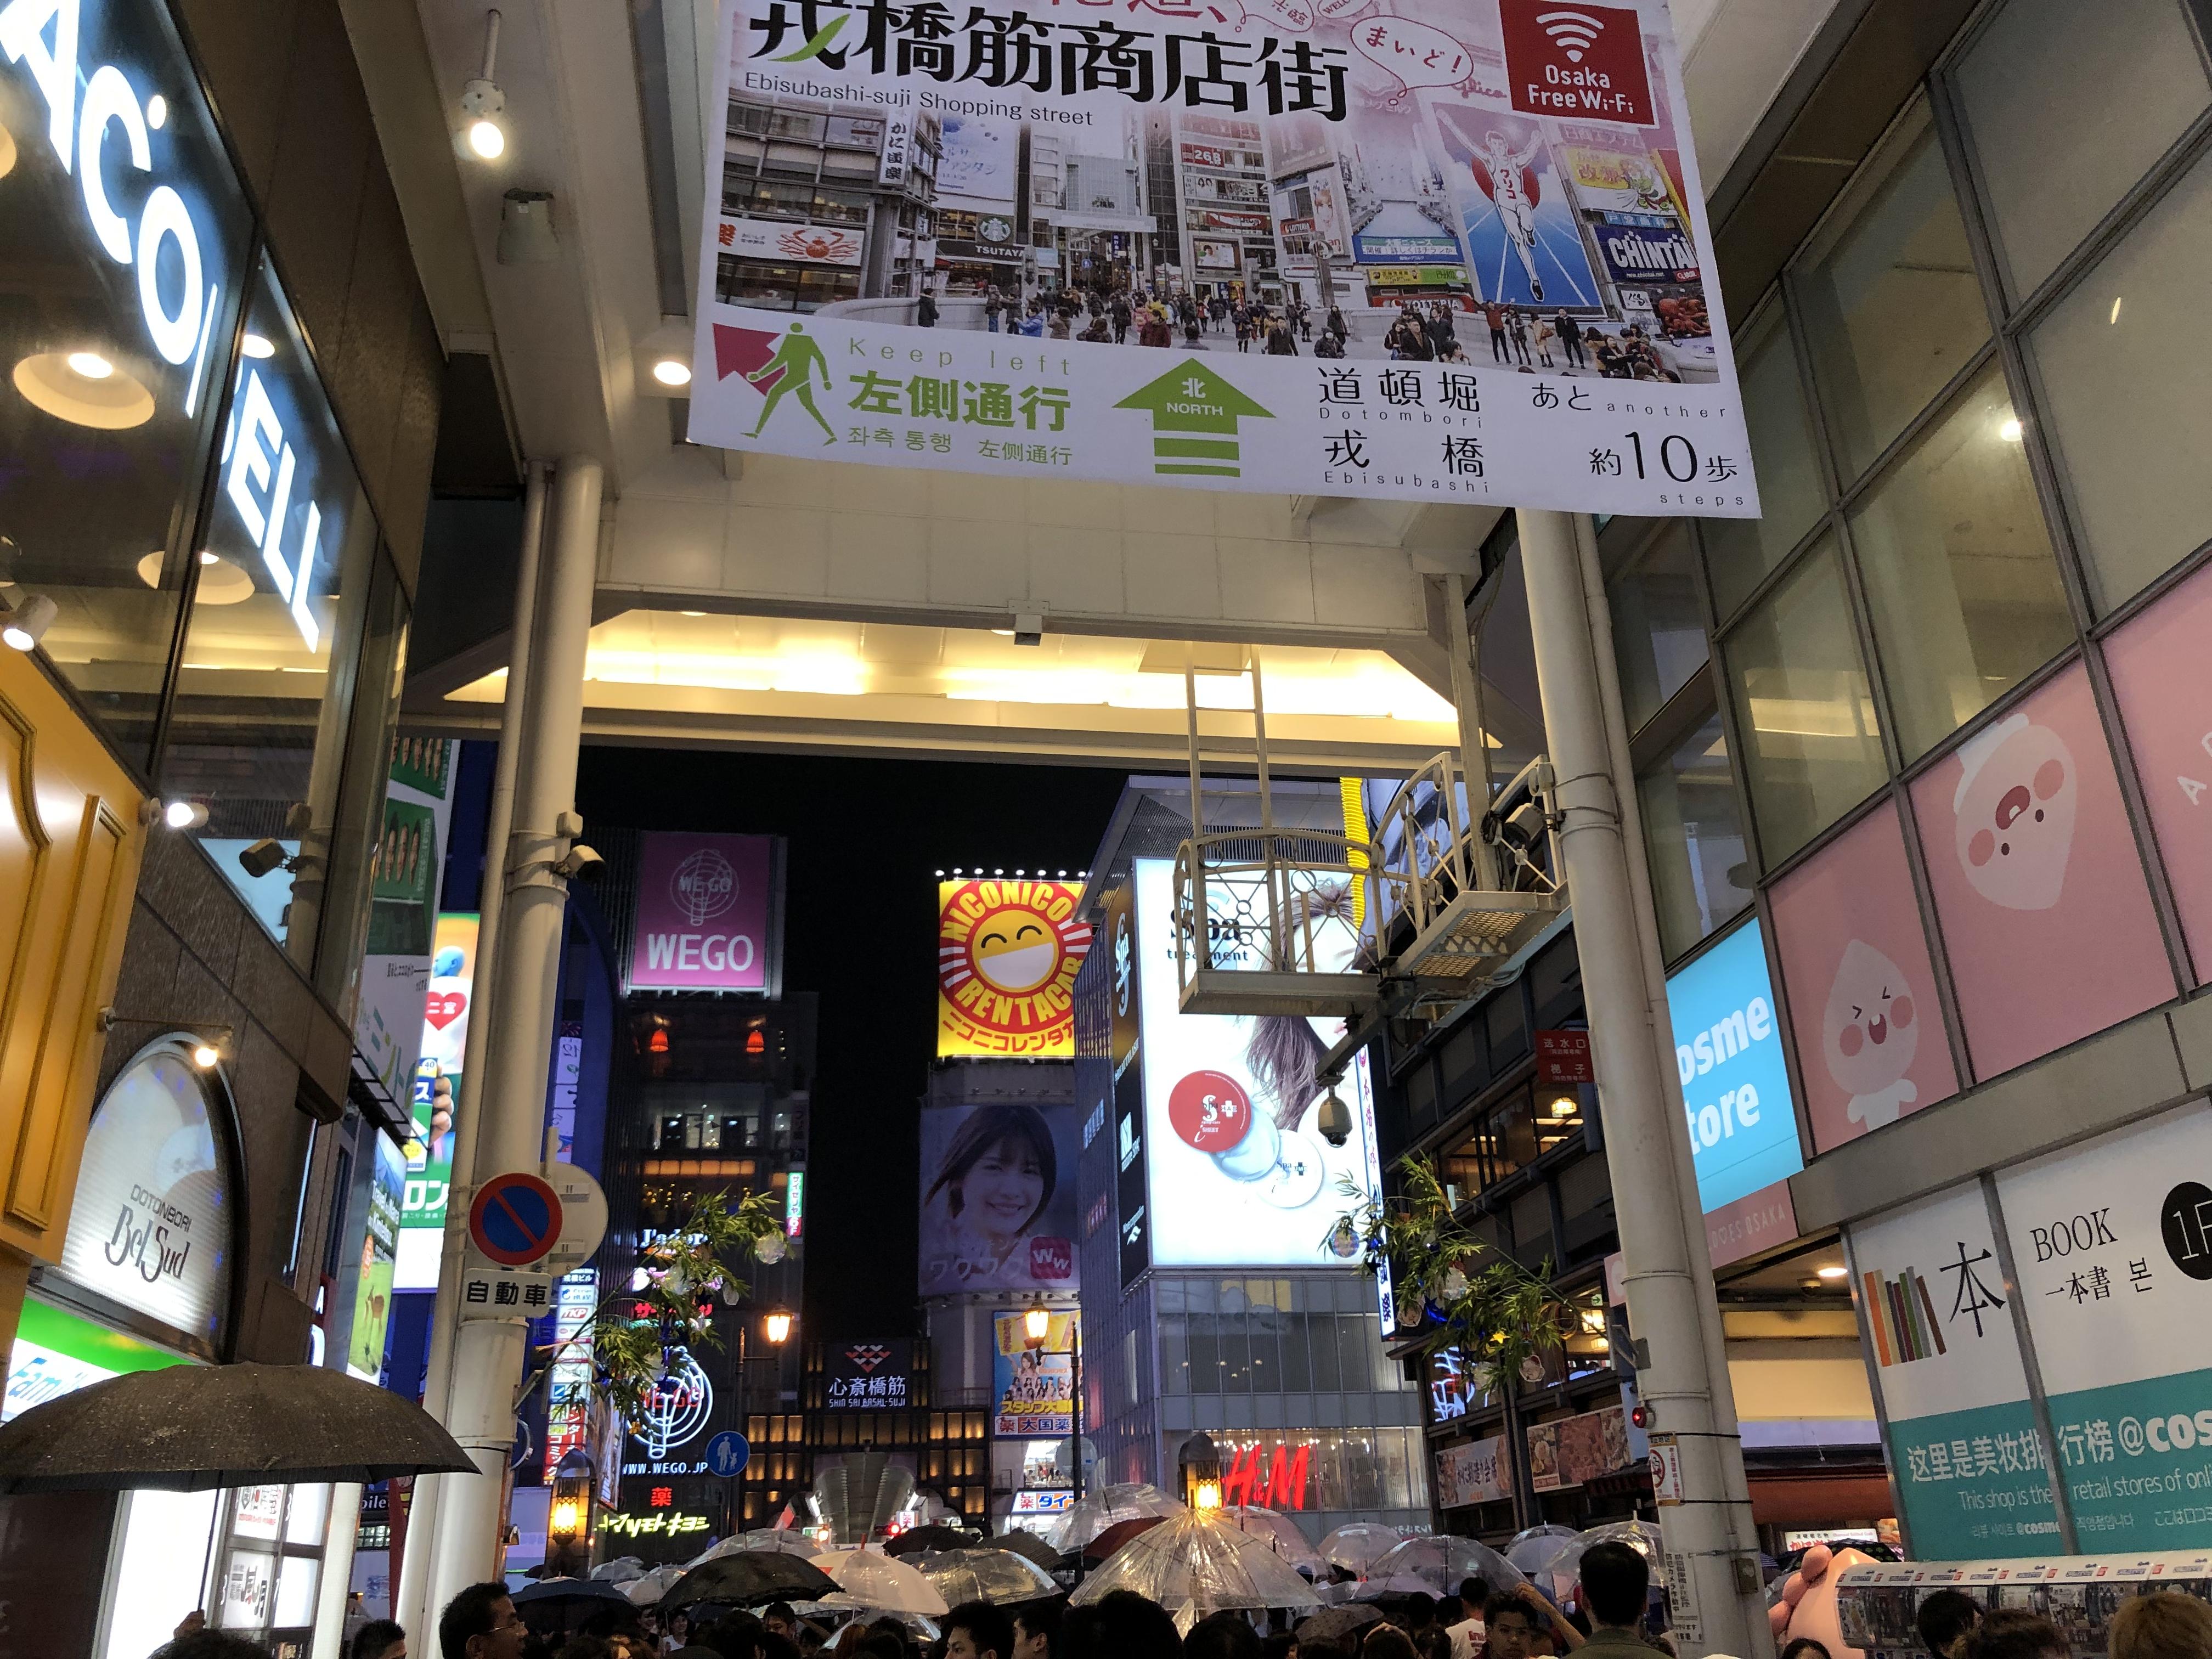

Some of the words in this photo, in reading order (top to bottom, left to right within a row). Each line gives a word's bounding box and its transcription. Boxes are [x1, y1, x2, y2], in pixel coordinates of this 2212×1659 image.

[748, 0, 1348, 122] 戎橋筋商店街
[1545, 64, 1611, 89] Osaka
[746, 71, 911, 107] Ebisubashi-suji
[919, 92, 1022, 120] Shopping
[1030, 106, 1093, 126] street
[1528, 84, 1576, 108] Free
[1577, 88, 1634, 114] Wi-Fi
[849, 337, 953, 367] Keep
[990, 350, 1070, 376] left
[847, 370, 1071, 432] 左側通行
[1182, 377, 1206, 399] 北
[1319, 366, 1480, 413] 道頓堀
[1532, 382, 1592, 411] あと
[1166, 402, 1223, 416] NORTH
[1319, 407, 1482, 428] Dotombori
[1607, 400, 1726, 418] another
[847, 426, 895, 448] 좌측
[905, 430, 952, 453] 통행
[1324, 471, 1489, 493] Ebisubashi
[1660, 493, 1744, 507] steps
[940, 881, 1073, 944] NICONICO
[647, 933, 754, 972] WEGO
[130, 1184, 193, 1233] DOTONBORI
[2029, 1207, 2119, 1263] BOOK
[466, 1280, 548, 1307] 自動車
[1939, 1241, 2007, 1338] 本
[2045, 1265, 2112, 1305] 一本書
[2129, 1256, 2154, 1294] 본
[562, 1307, 587, 1318] TKP
[828, 1375, 906, 1397] 心斎橋筋
[650, 1487, 673, 1507] 薬
[1957, 1487, 1985, 1511] This
[1986, 1486, 2016, 1512] shop
[2017, 1486, 2029, 1506] is
[2029, 1485, 2054, 1504] the
[2072, 1475, 2112, 1501] retail
[2113, 1476, 2163, 1497] stores
[2164, 1468, 2181, 1493] of
